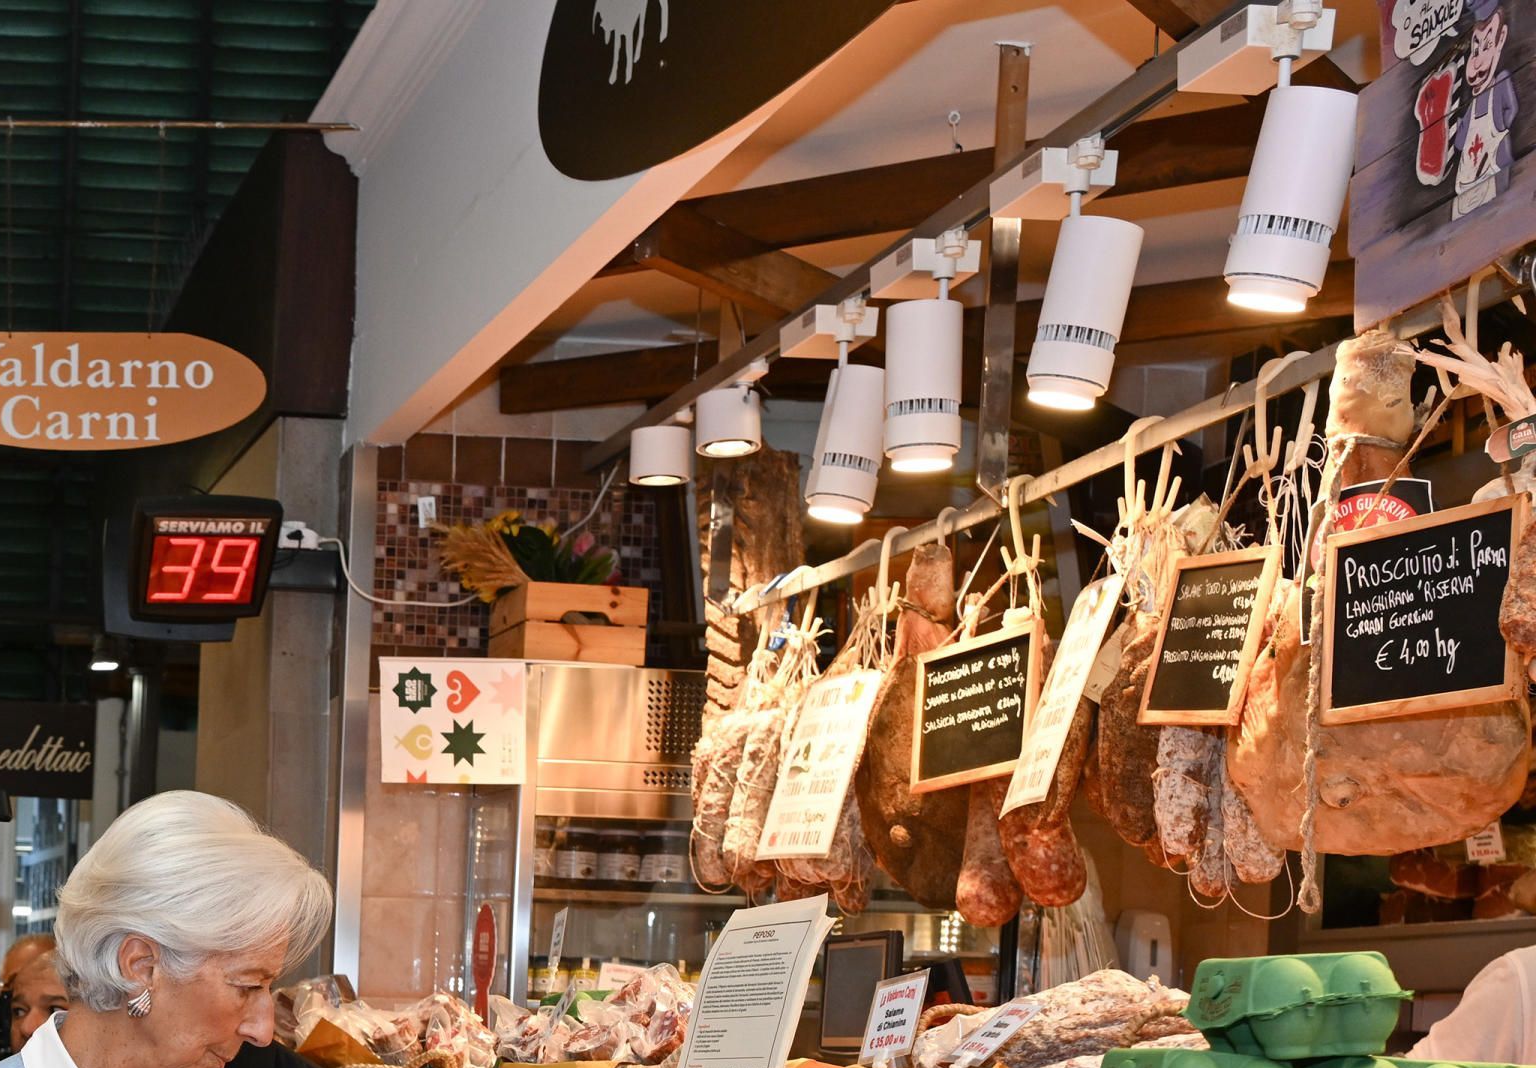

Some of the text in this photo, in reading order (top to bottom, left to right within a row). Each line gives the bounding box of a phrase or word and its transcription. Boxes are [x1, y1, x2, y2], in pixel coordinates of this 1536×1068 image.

[0, 395, 161, 441] Carni
[158, 520, 265, 534] SERVIAMO IL
[150, 538, 257, 600] 39
[1375, 639, 1394, 671] €
[1399, 638, 1430, 665] 4,00
[752, 929, 776, 939] PEPOSO
[884, 1007, 905, 1019] Salame
[883, 1018, 907, 1031] Chianina
